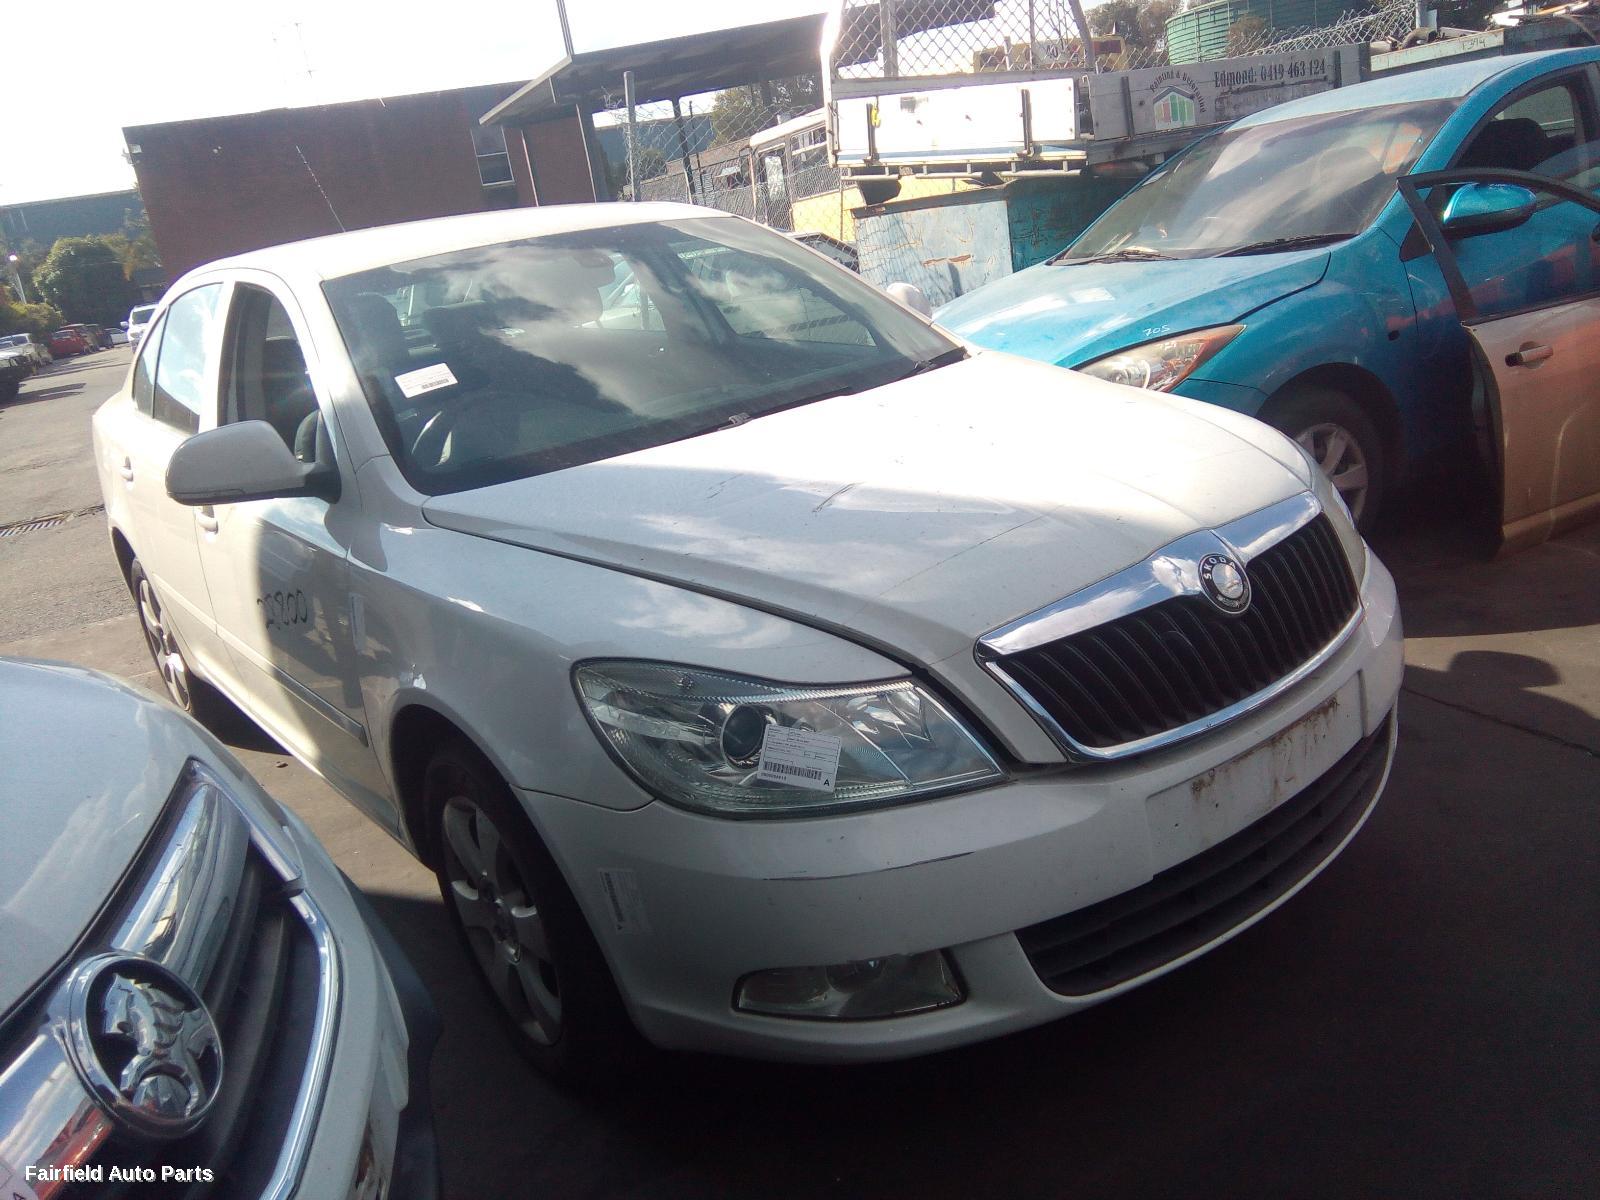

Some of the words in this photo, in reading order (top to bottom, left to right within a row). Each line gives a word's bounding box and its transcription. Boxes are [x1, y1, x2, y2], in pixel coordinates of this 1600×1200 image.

[1260, 63, 1284, 81] 0419
[1287, 59, 1306, 79] 463
[1309, 58, 1326, 76] 124
